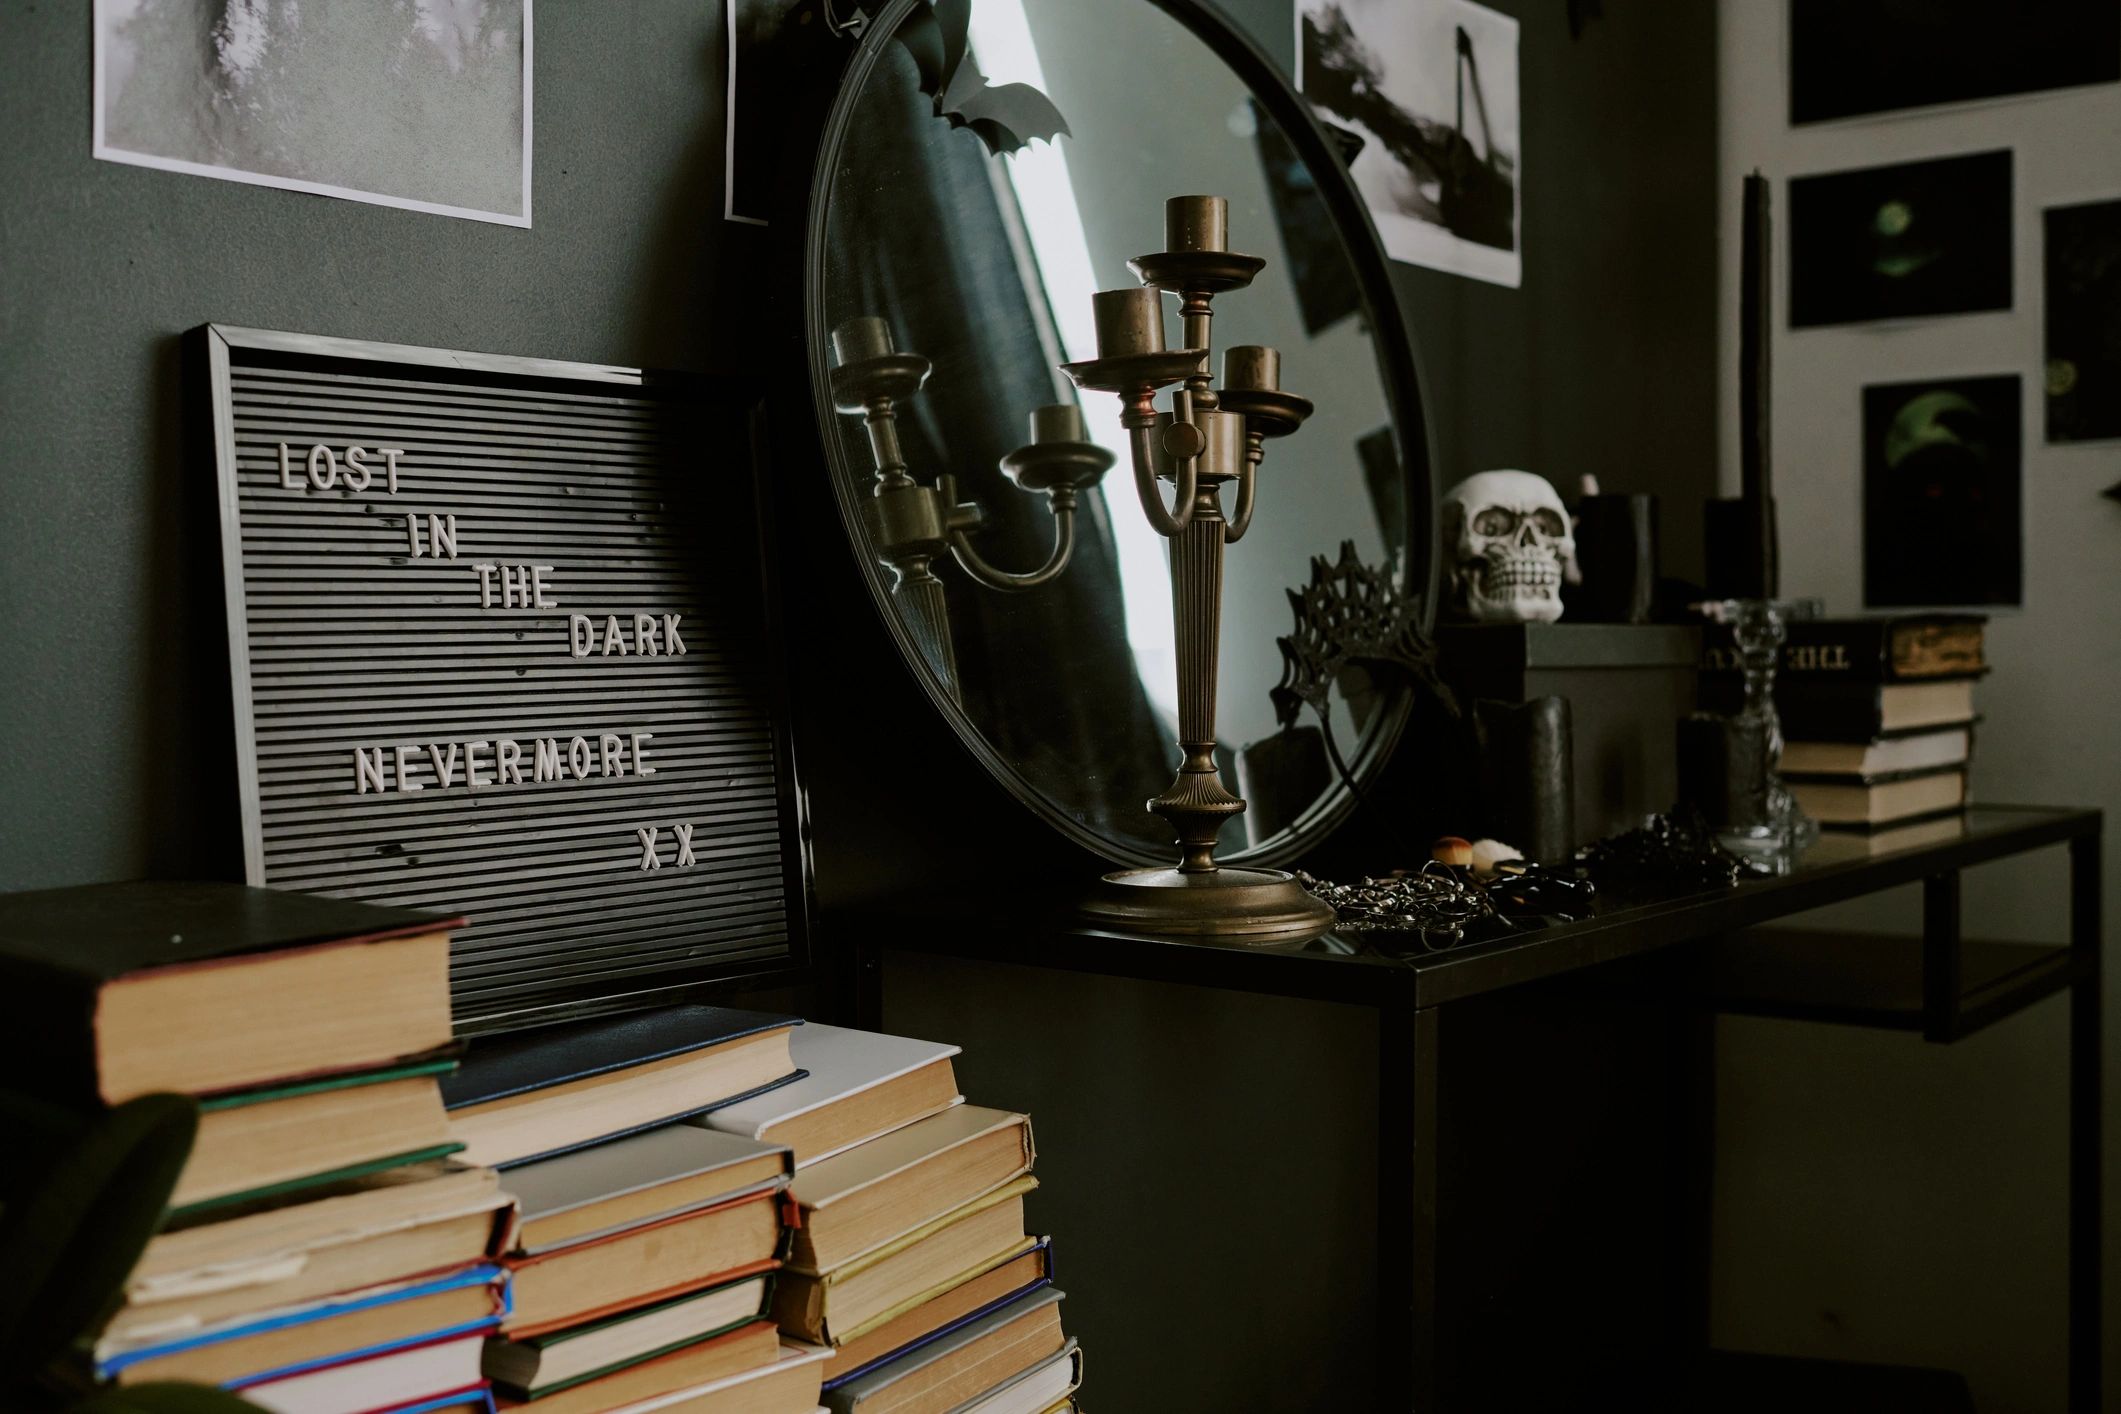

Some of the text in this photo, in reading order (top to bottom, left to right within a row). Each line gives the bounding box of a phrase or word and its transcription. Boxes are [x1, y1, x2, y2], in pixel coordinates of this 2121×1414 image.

[279, 442, 405, 494] LOST
[407, 513, 458, 560] IN
[471, 563, 558, 609] THE
[569, 613, 687, 658] DARK
[354, 733, 656, 795] NEVERMORE
